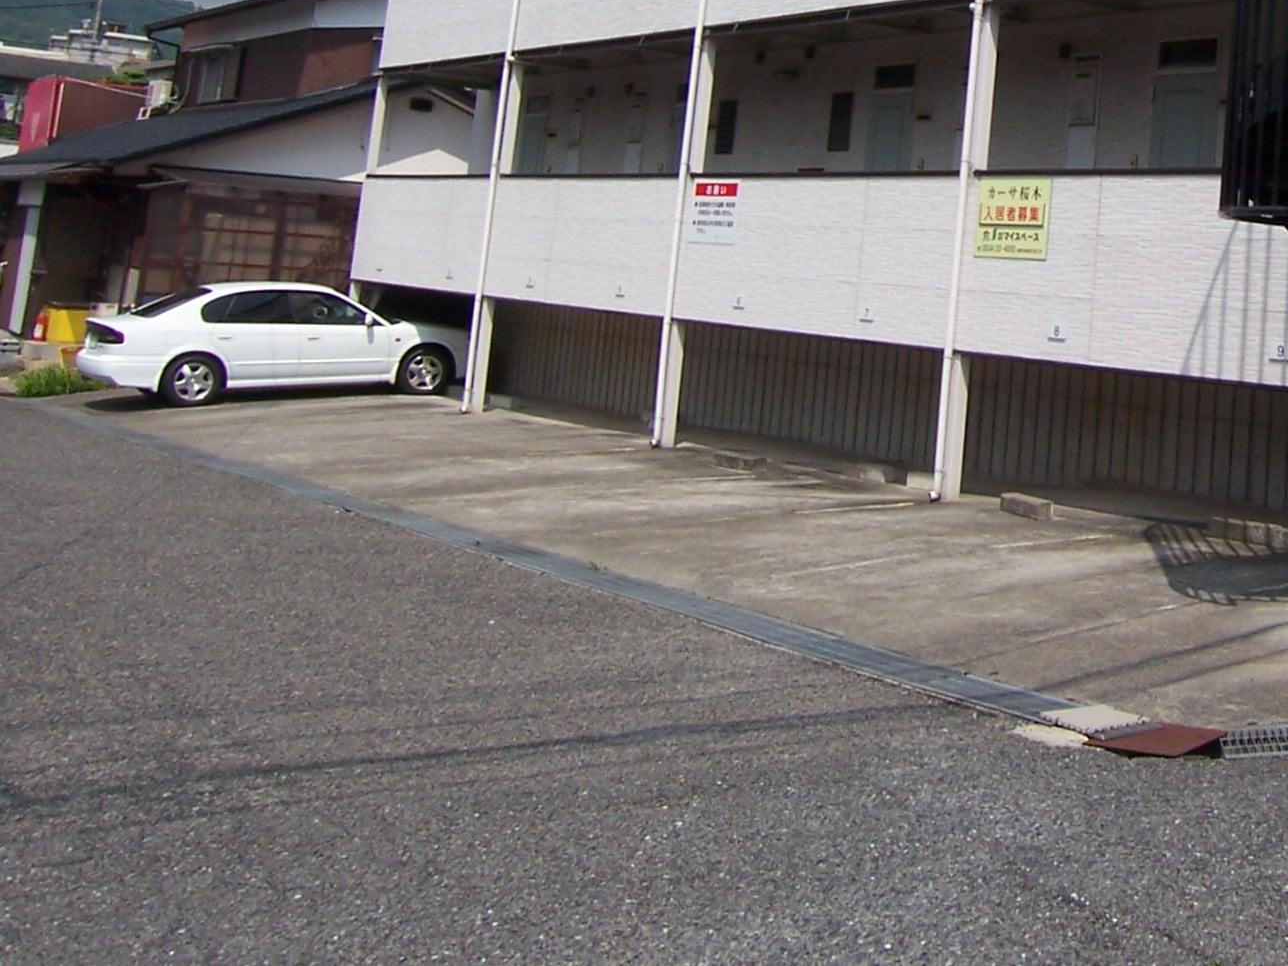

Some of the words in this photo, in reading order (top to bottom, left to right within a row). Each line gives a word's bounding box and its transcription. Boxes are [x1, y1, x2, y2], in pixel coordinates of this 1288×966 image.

[988, 185, 1042, 201] カーサ桜木
[983, 205, 1040, 222] 入居者募集
[1053, 325, 1060, 337] 8
[1276, 344, 1285, 358] 9
